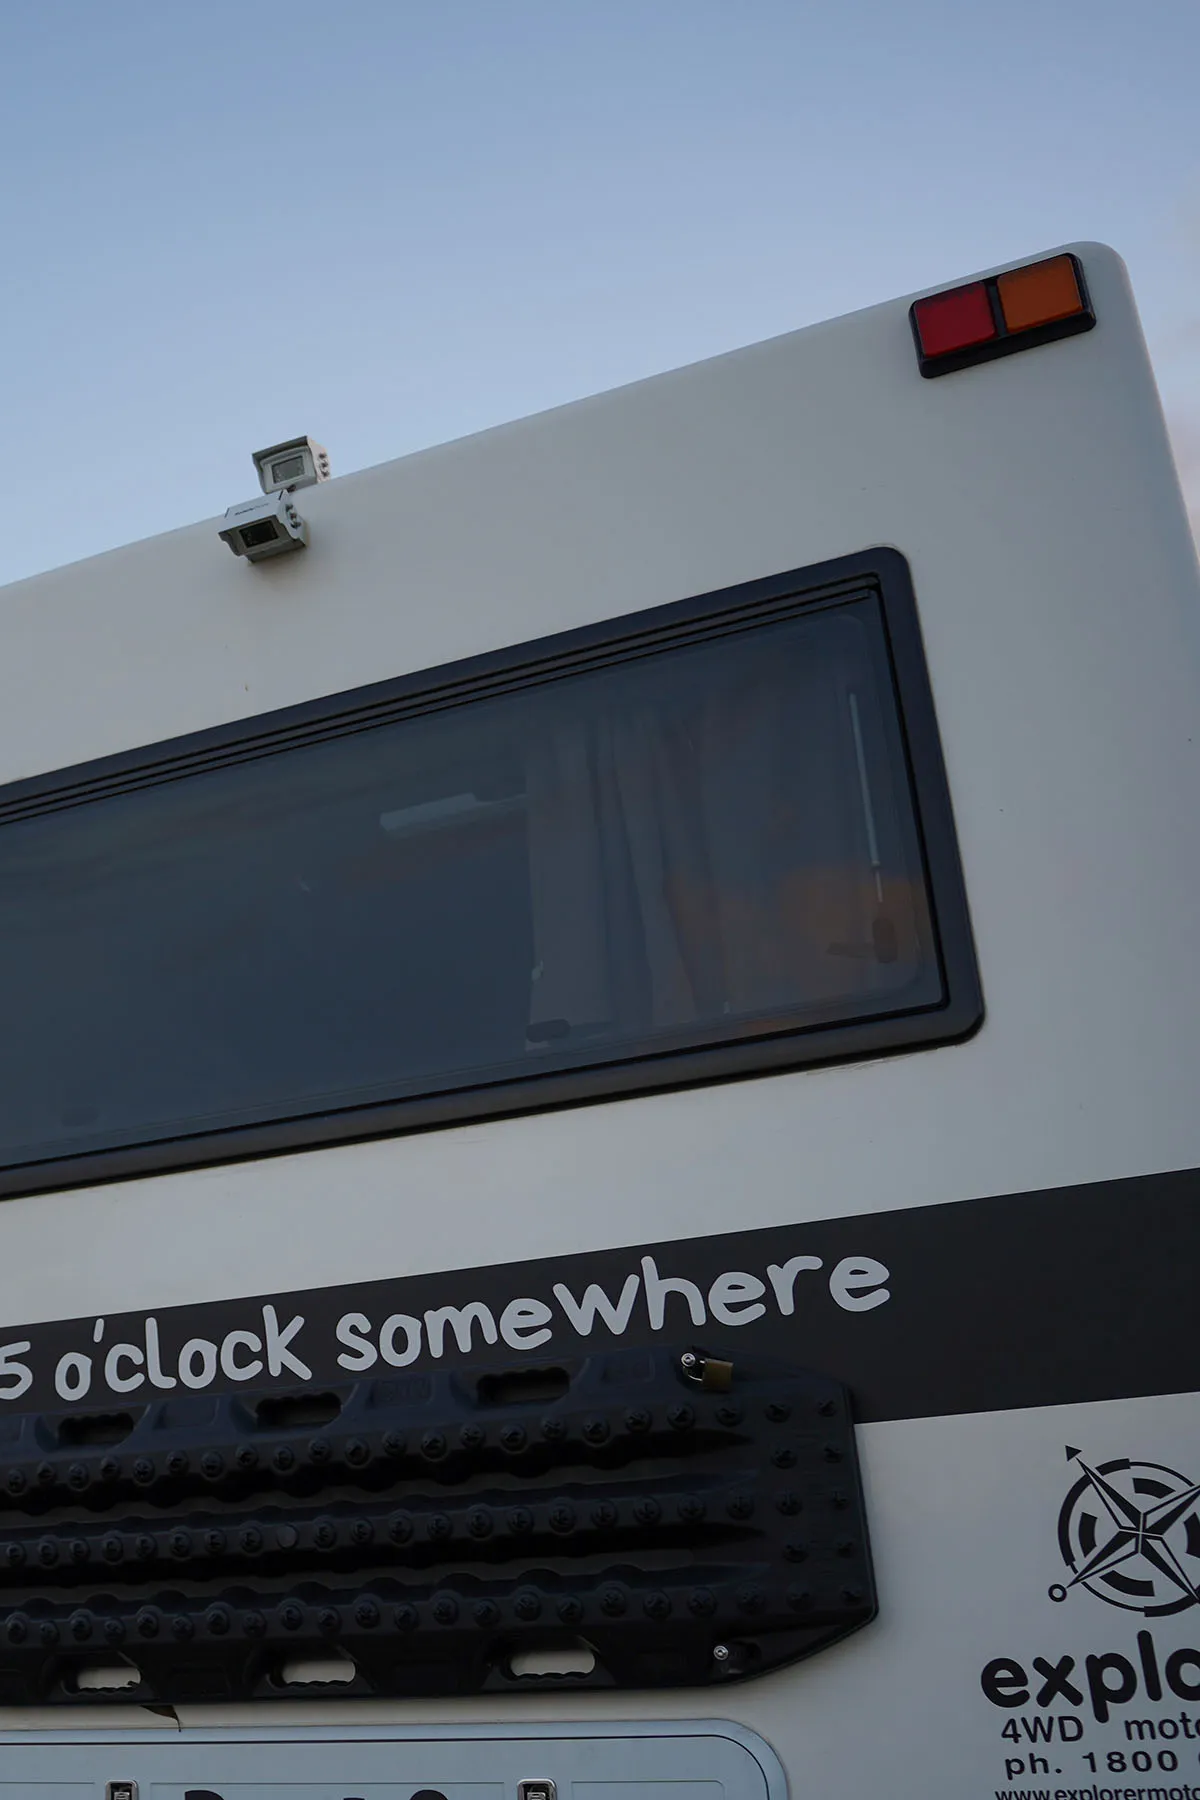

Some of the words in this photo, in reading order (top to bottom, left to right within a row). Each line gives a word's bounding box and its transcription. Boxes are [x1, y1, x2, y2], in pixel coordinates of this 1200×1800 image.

[54, 1304, 313, 1402] o'clock
[335, 1255, 891, 1372] somewhere
[980, 1629, 1200, 1724] explo
[1000, 1715, 1084, 1744] 4WD
[1123, 1711, 1200, 1741] mot
[1004, 1752, 1063, 1781] ph.
[1081, 1750, 1179, 1774] 1800
